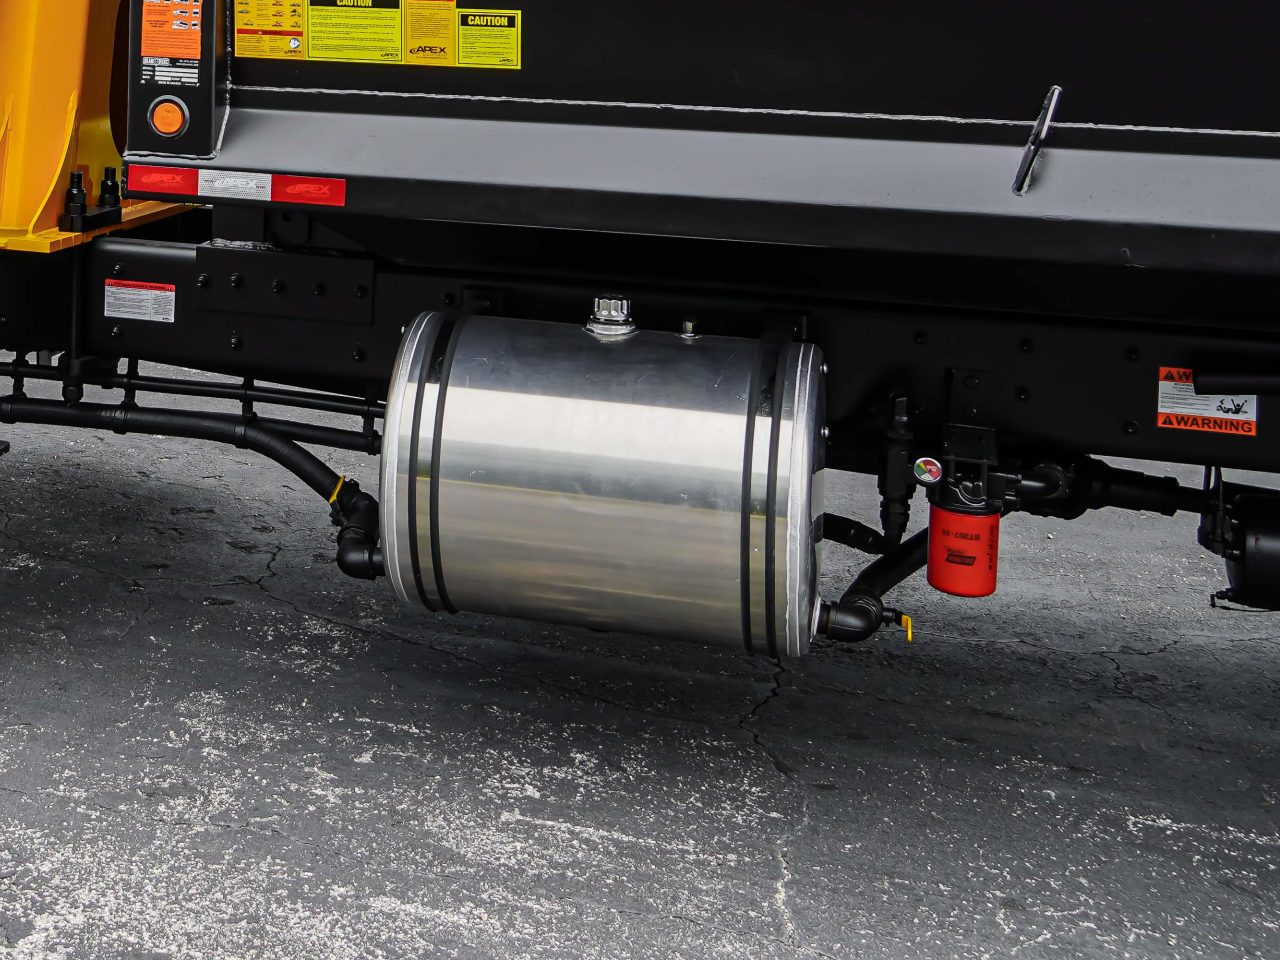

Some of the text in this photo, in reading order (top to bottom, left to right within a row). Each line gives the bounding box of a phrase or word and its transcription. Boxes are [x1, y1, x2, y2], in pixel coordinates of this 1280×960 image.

[468, 16, 508, 26] CAUTION
[415, 46, 447, 54] APEX
[1175, 415, 1253, 433] WARNING
